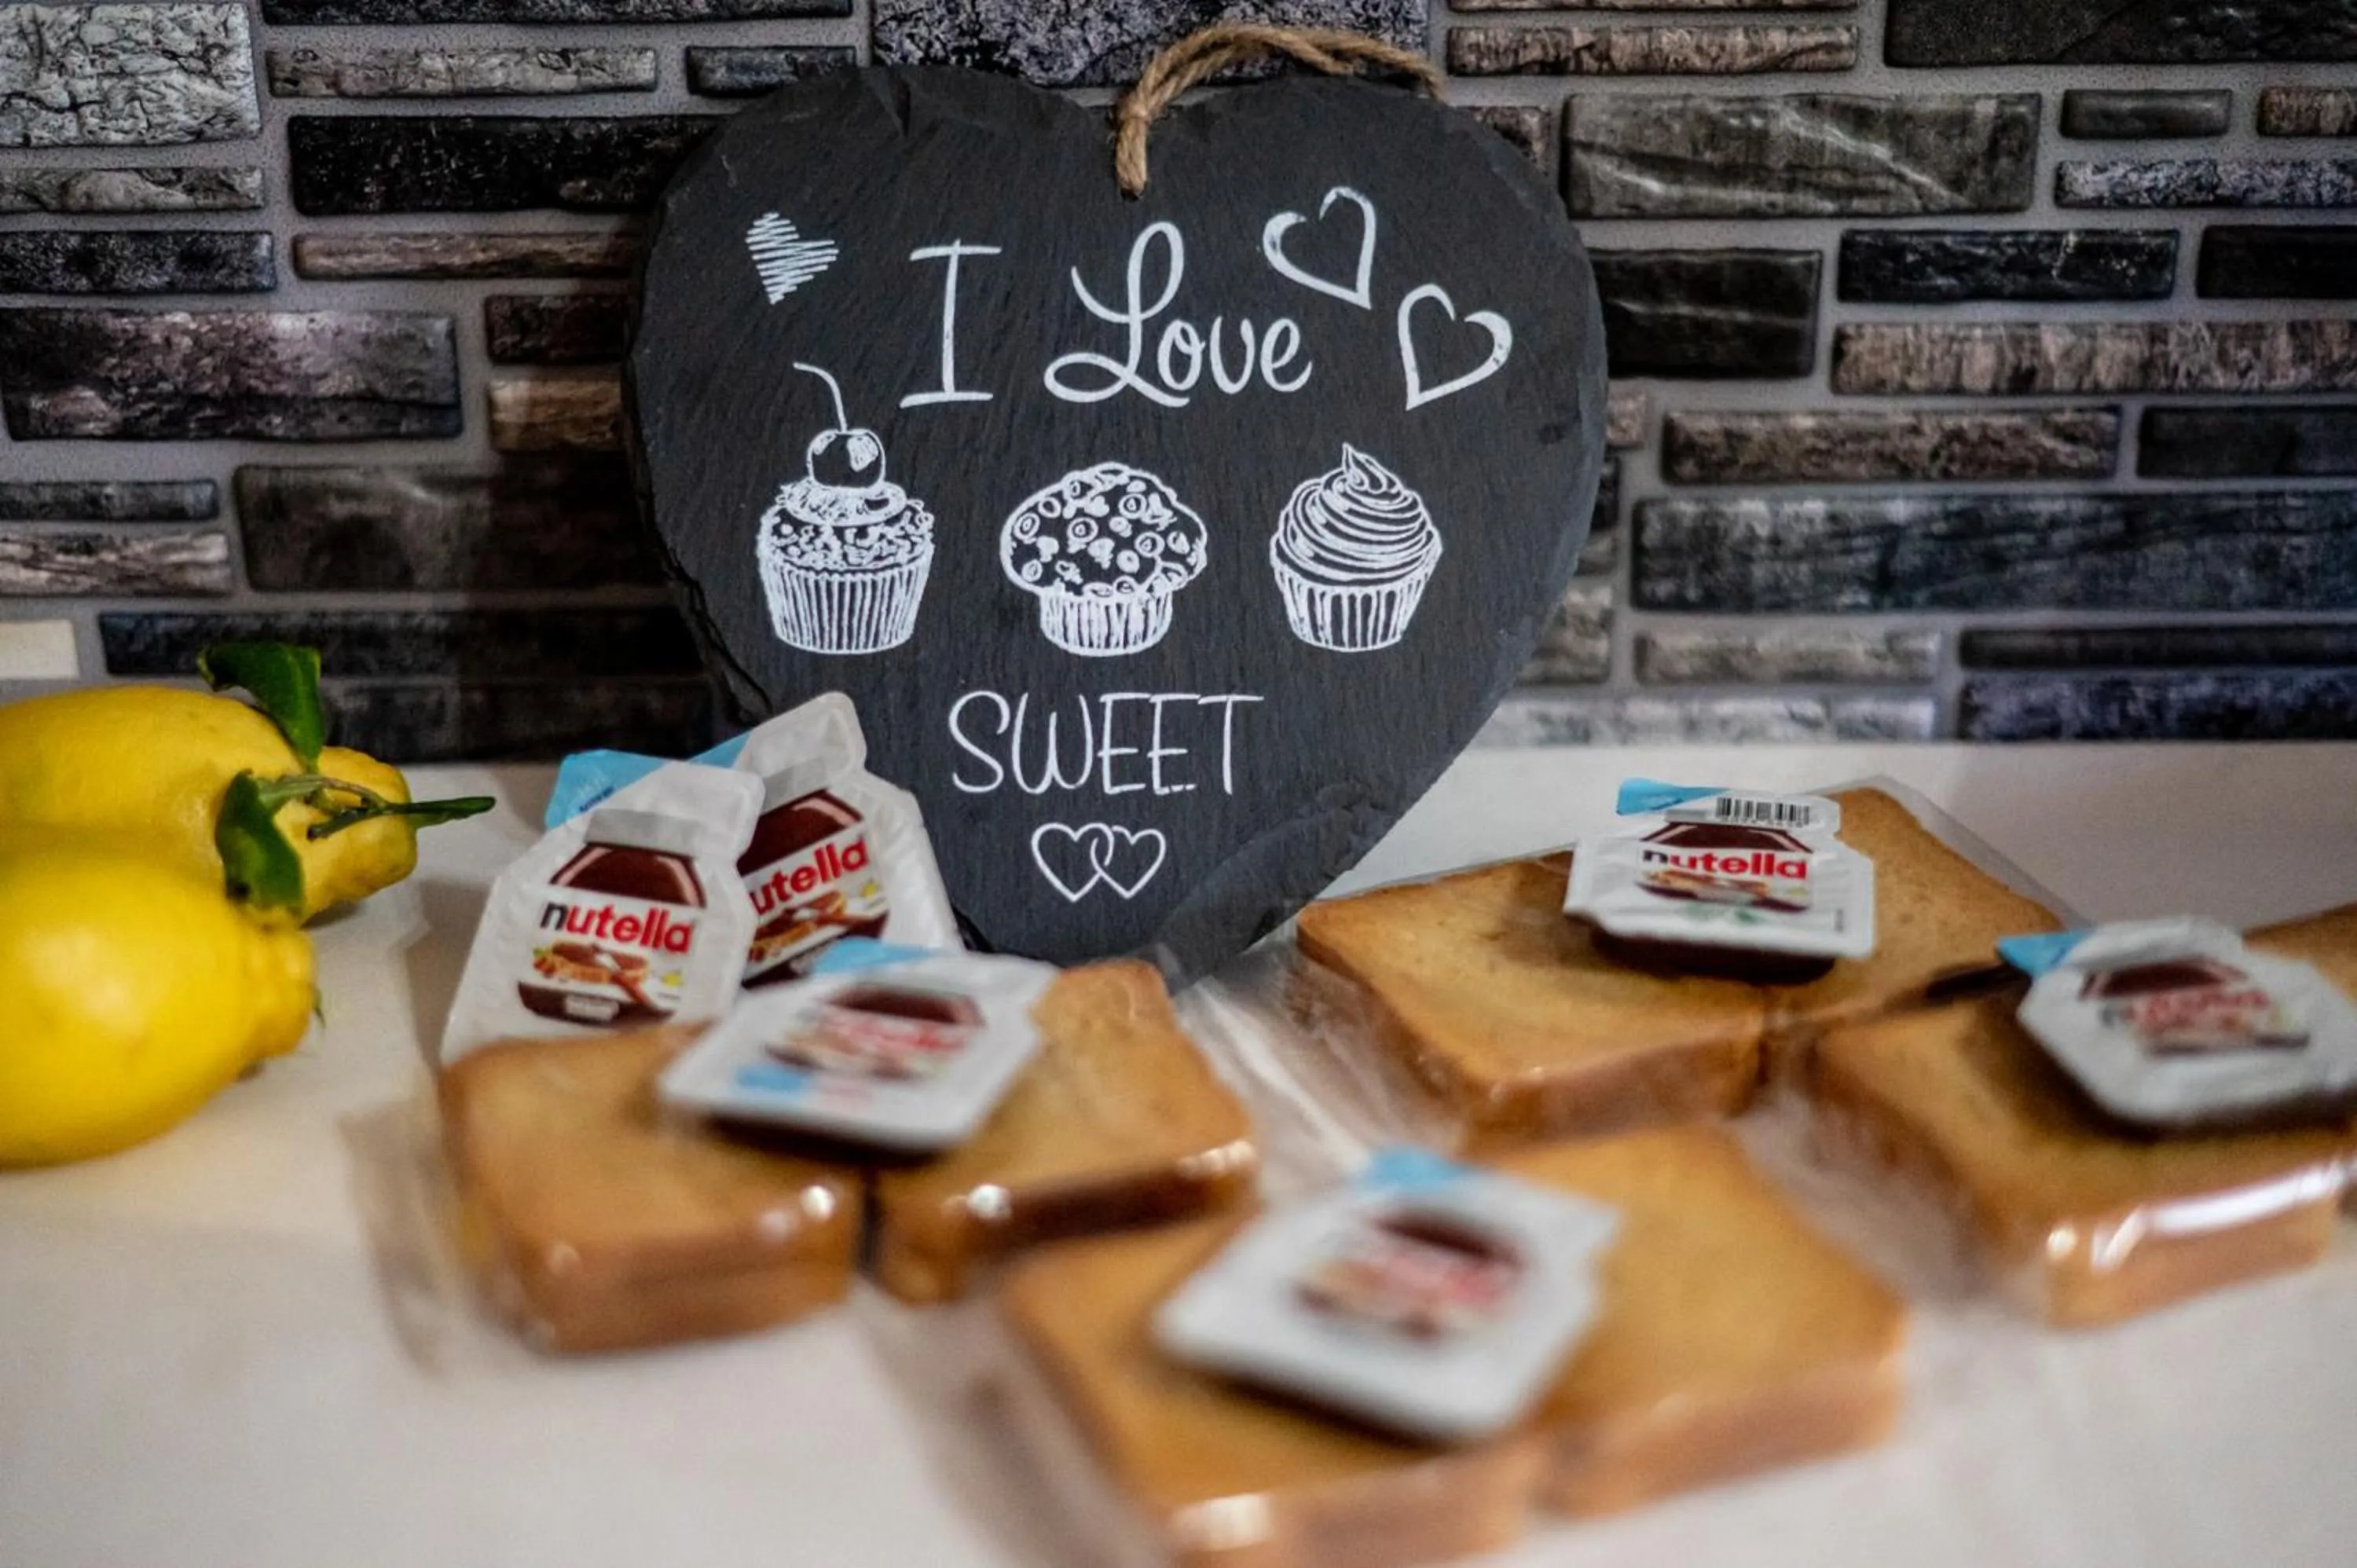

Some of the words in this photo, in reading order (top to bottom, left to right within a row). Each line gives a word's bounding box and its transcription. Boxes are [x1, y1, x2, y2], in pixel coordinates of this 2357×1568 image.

[899, 238, 1003, 409] I
[1043, 220, 1314, 408] Love
[948, 689, 1265, 796] SWEET
[749, 836, 871, 916] utella
[1642, 848, 1808, 881] nutella
[539, 900, 696, 955] nutella
